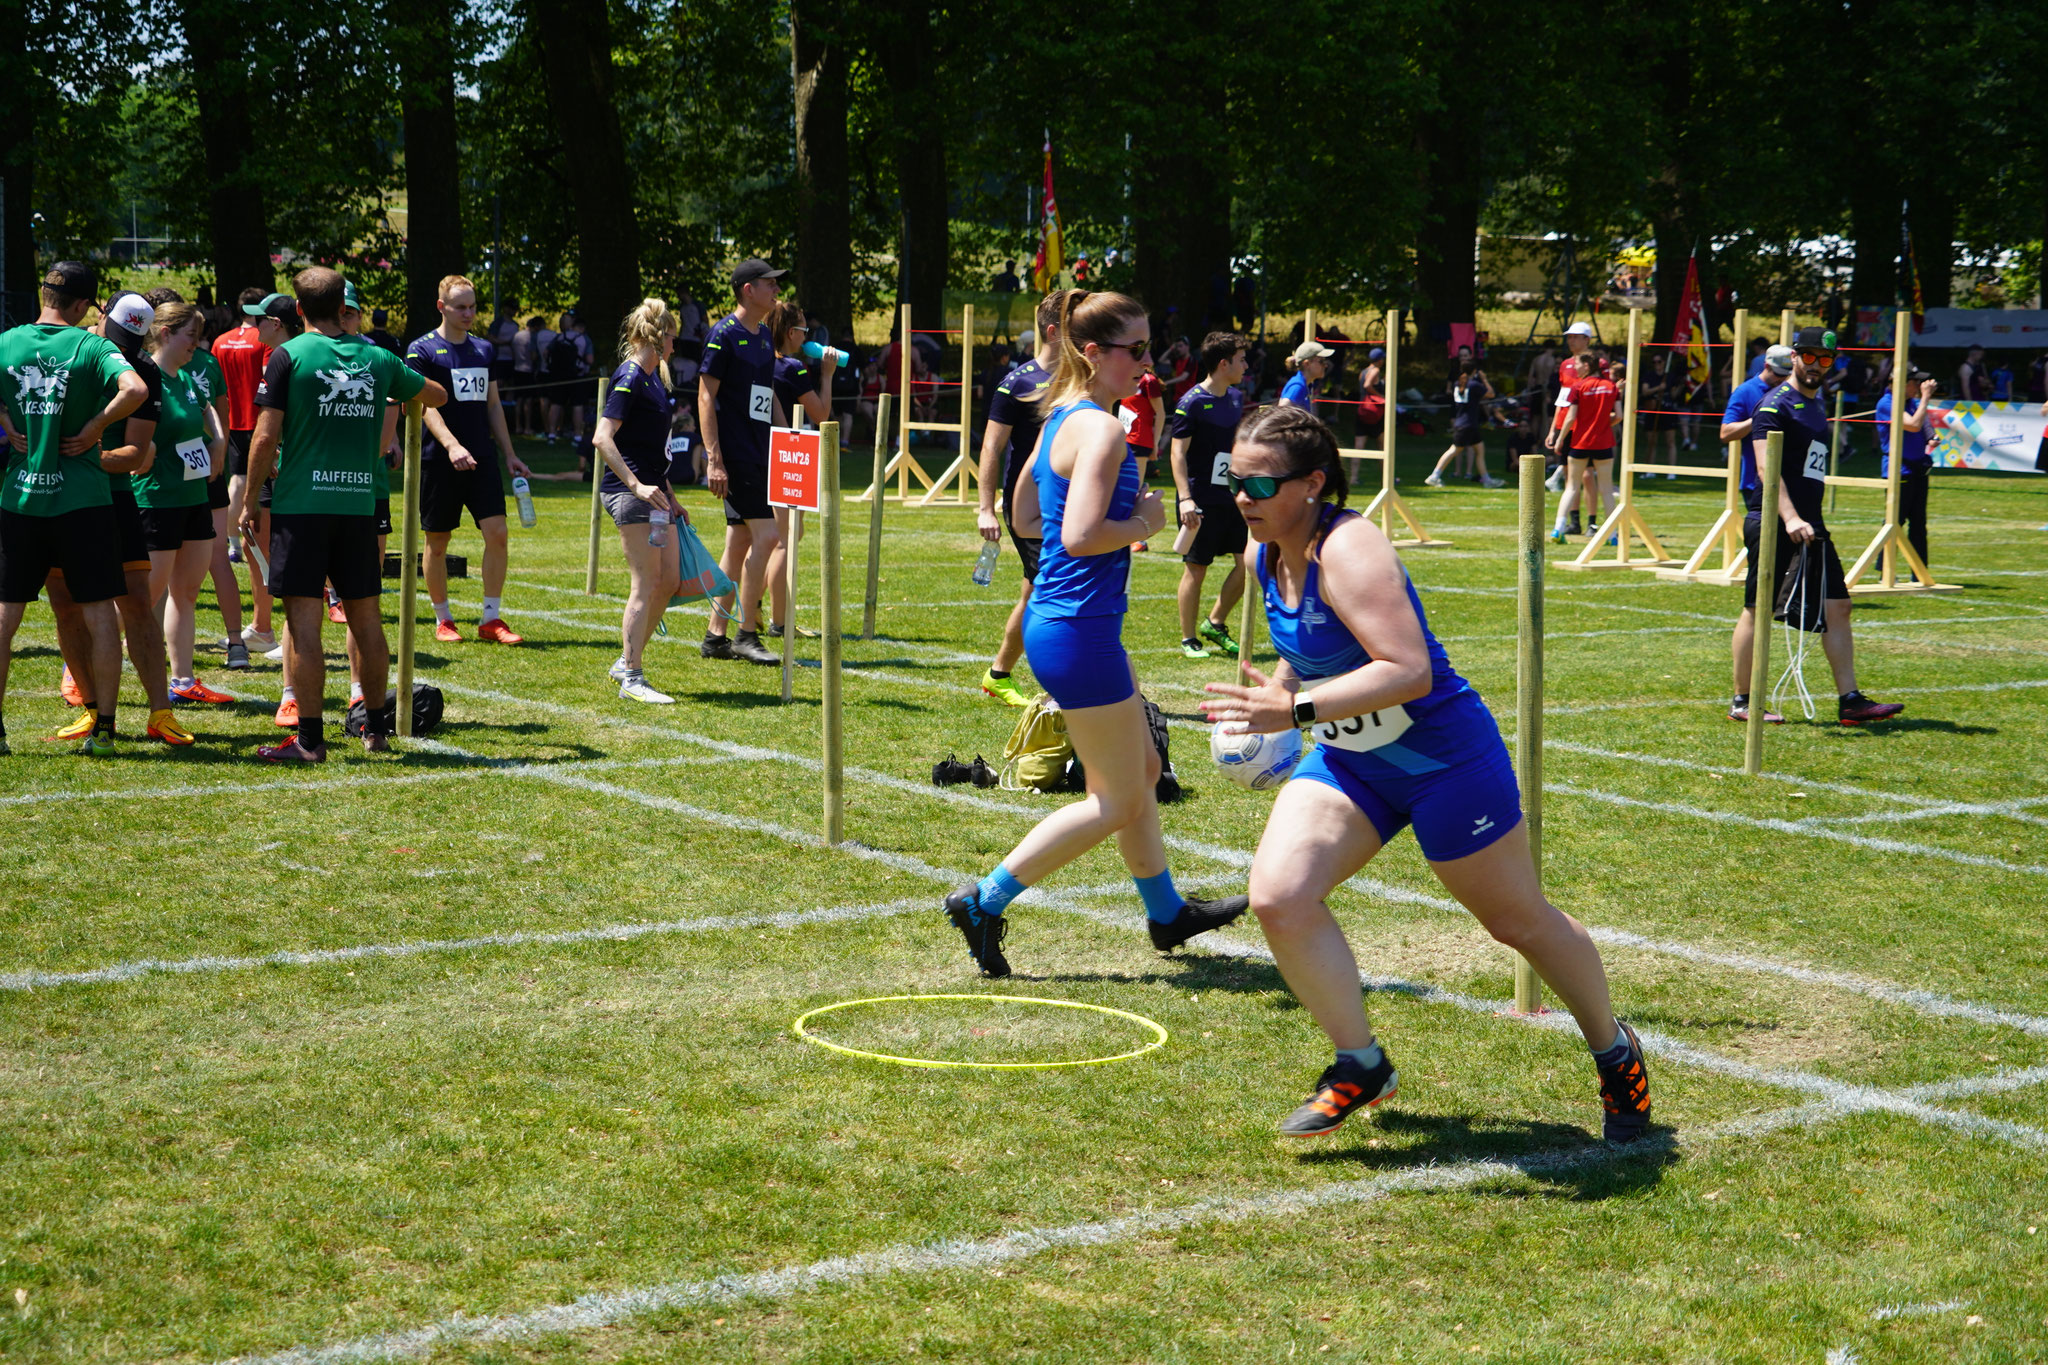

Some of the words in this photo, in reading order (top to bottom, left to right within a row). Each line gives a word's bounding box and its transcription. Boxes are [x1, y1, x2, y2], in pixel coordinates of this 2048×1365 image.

[458, 376, 485, 393] 219
[319, 402, 333, 417] TV
[333, 402, 375, 418] KESSWIL
[183, 448, 209, 471] 367
[778, 449, 792, 464] TBA
[961, 895, 982, 927] FILA
